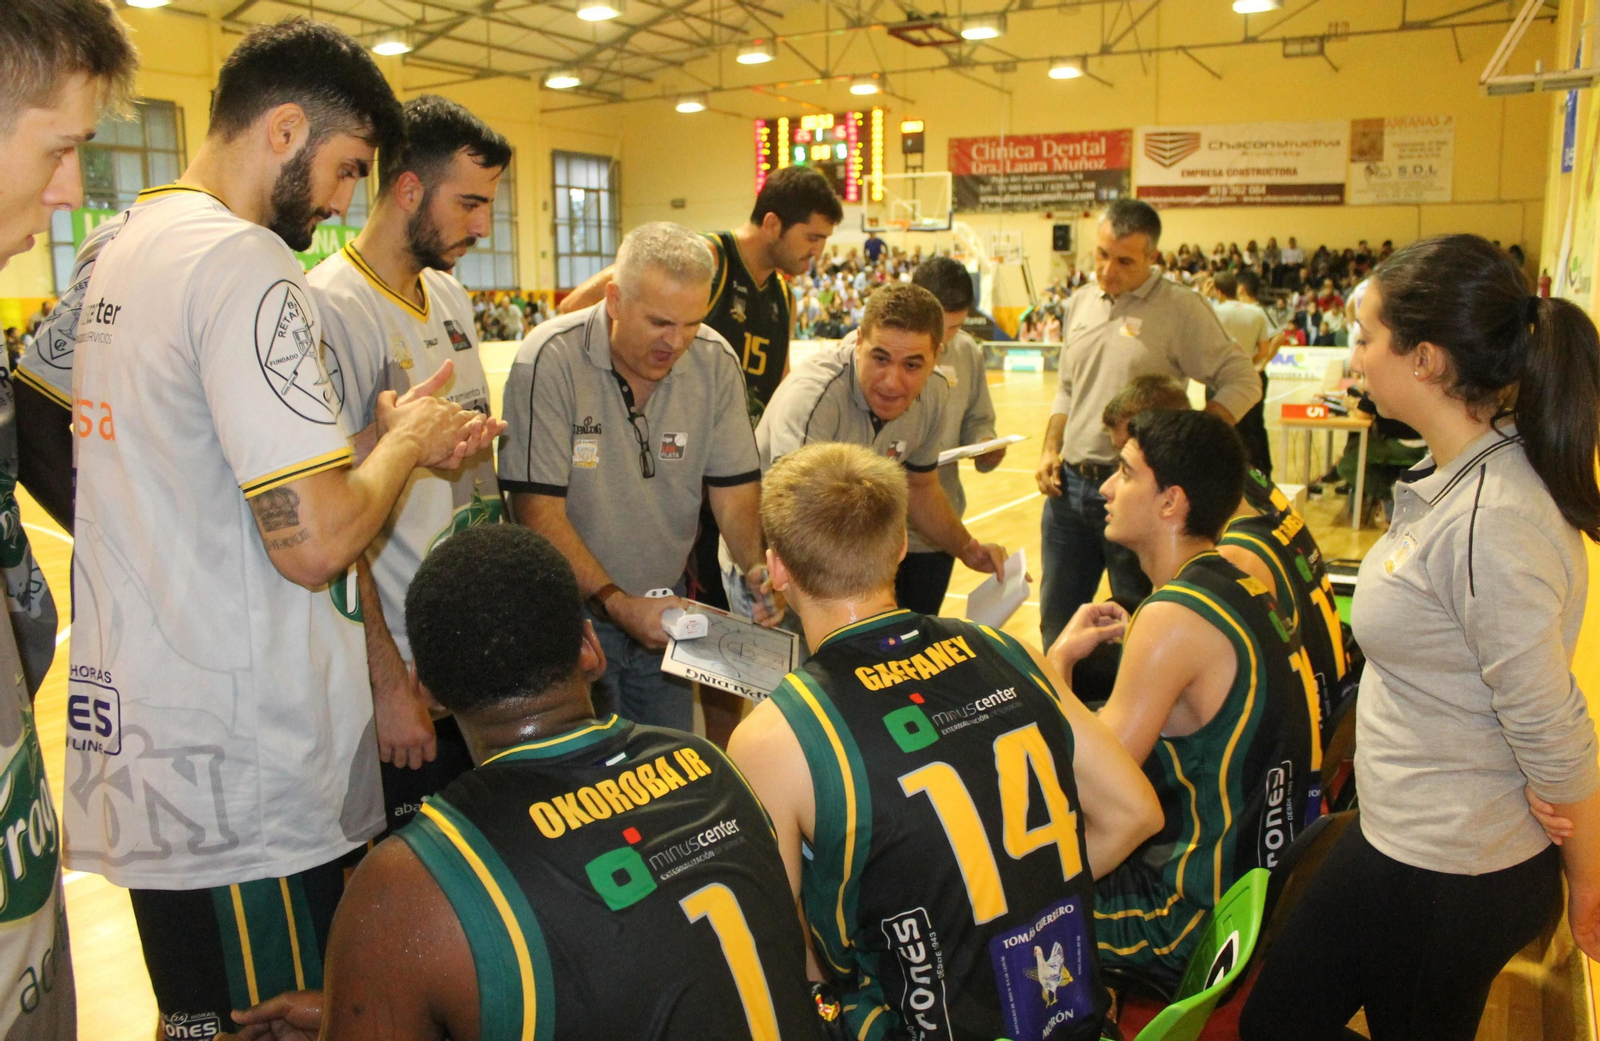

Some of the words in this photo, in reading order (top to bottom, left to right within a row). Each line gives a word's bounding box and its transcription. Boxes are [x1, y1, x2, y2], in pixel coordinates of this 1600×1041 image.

[971, 140, 1035, 161] Clínica
[1041, 136, 1106, 159] Dental
[971, 161, 1000, 175] Dra.
[1005, 159, 1048, 174] Laura
[1053, 156, 1107, 172] Muñoz
[1181, 167, 1224, 178] EMPRESA
[1226, 166, 1298, 177] CONSTRUCTORA
[269, 353, 299, 366] FUNDADO
[743, 332, 770, 376] 15
[77, 398, 116, 442] sa
[70, 664, 112, 684] HORAS
[854, 635, 977, 691] GAFFANEY
[685, 667, 769, 701] PALDING
[68, 694, 113, 738] ES
[528, 755, 688, 840] OKOROBA
[672, 747, 712, 782] JR
[897, 721, 1084, 926] 14
[648, 818, 740, 872] minuscenter
[678, 882, 783, 1041] 1
[173, 1014, 186, 1022] 24
[1042, 1008, 1075, 1040] MORÓN
